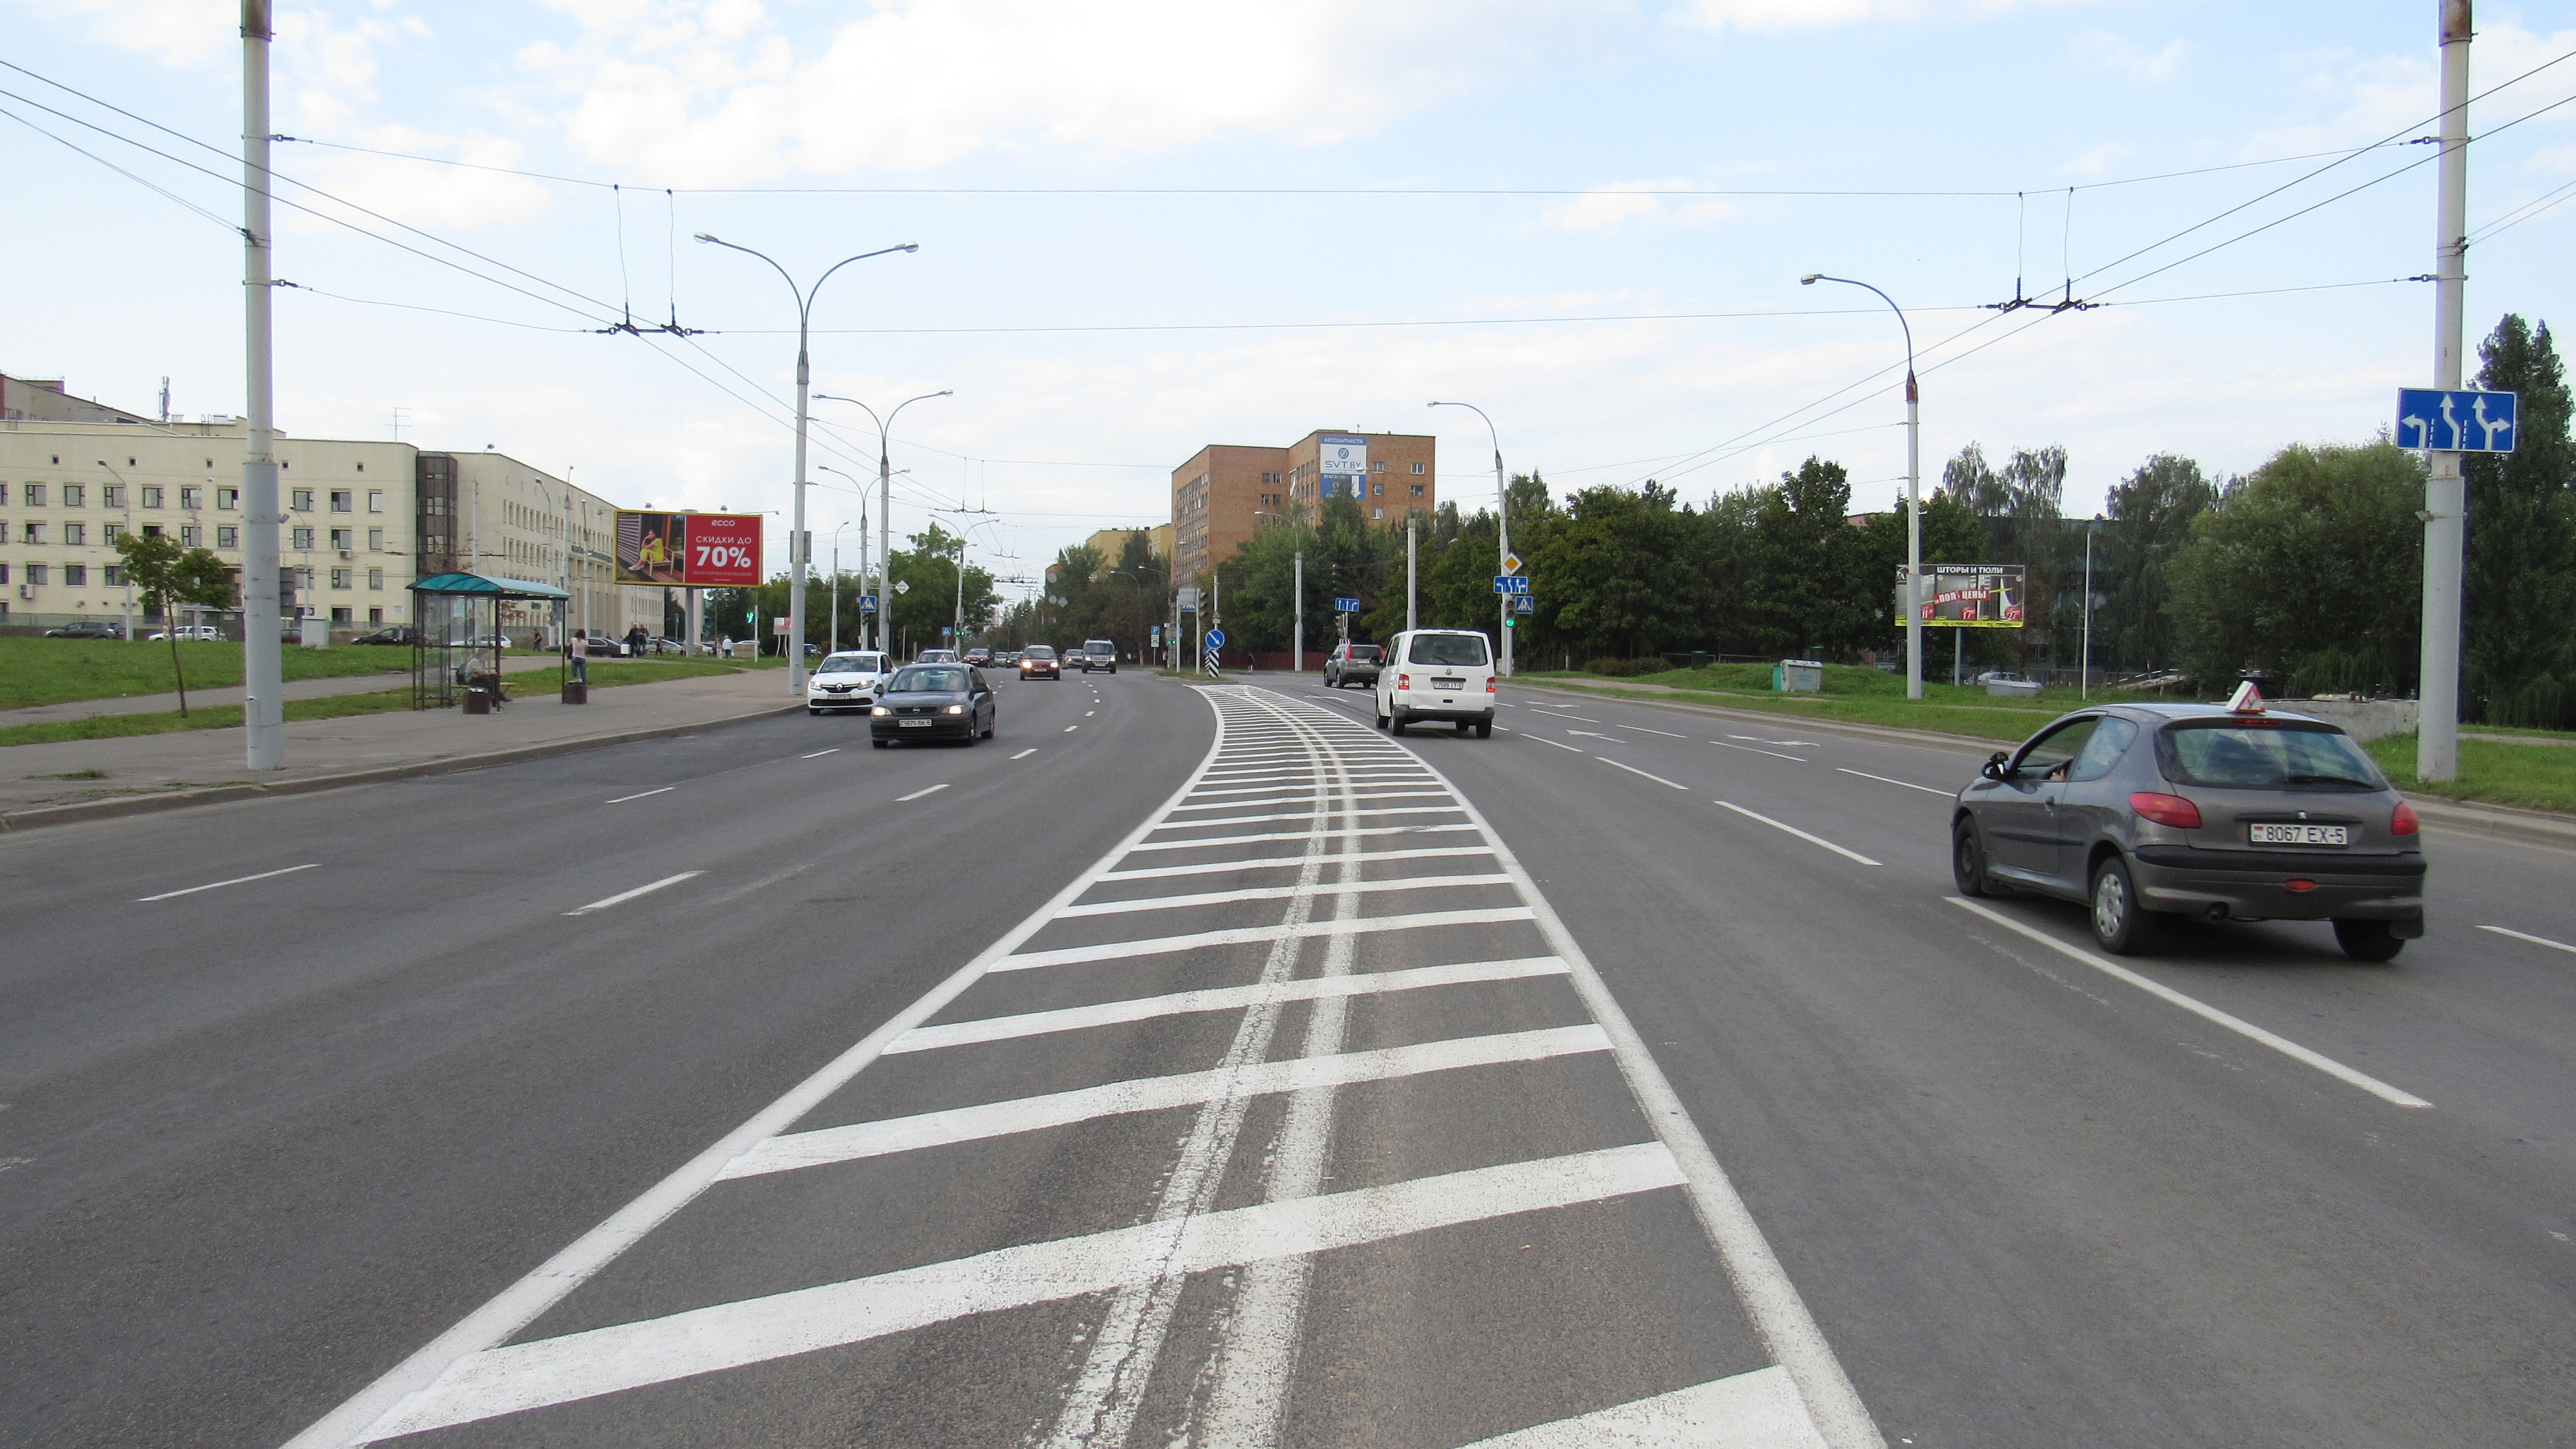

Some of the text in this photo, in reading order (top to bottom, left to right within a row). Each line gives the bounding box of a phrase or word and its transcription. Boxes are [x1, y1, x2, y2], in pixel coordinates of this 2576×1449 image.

[1325, 461, 1361, 469] SVT.BY
[696, 536, 733, 544] СКИДКИ
[697, 546, 751, 568] 70%
[1939, 592, 1957, 603] ПОЛ
[1962, 590, 1986, 600] ЦЕНЫ
[2266, 826, 2344, 843] 8067 EX-5
